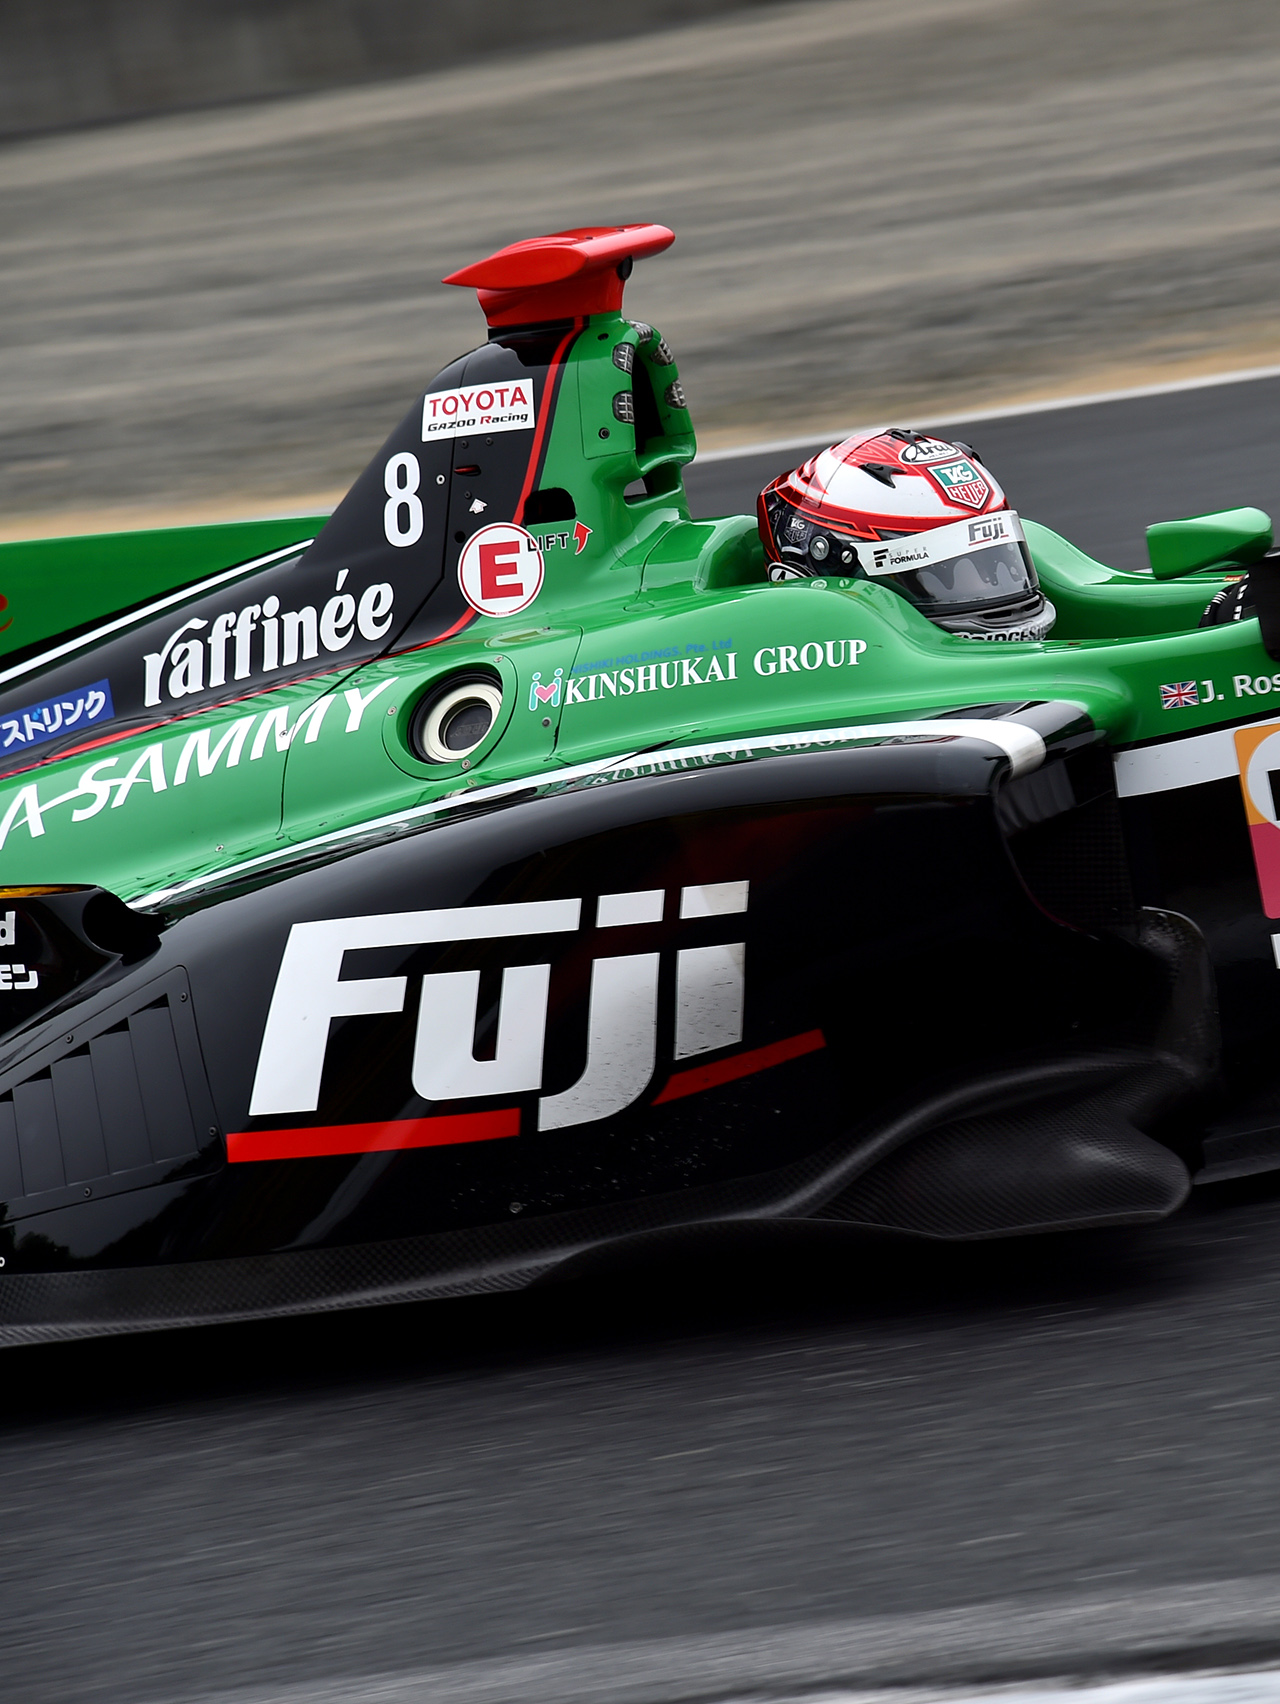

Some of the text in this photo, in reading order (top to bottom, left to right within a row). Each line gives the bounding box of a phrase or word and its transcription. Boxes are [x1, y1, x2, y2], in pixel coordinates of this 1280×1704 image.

[429, 386, 528, 417] TOYOTA
[427, 413, 528, 432] GAZOO Racing
[940, 465, 974, 484] TAG
[384, 451, 424, 548] 8
[949, 482, 986, 504] HEUER
[968, 517, 1004, 541] Fuji
[526, 532, 569, 552] LIFT
[888, 546, 928, 558] SUPER
[479, 540, 524, 600] E
[889, 552, 930, 566] FORMULA
[143, 568, 394, 707] raffinée
[712, 638, 733, 650] Ltd
[564, 639, 867, 705] KINSHUKAI GROUP
[1200, 680, 1225, 703] J.
[0, 690, 106, 748] スドリンク
[71, 676, 400, 823] SAMMY
[249, 880, 750, 1132] Fuji
